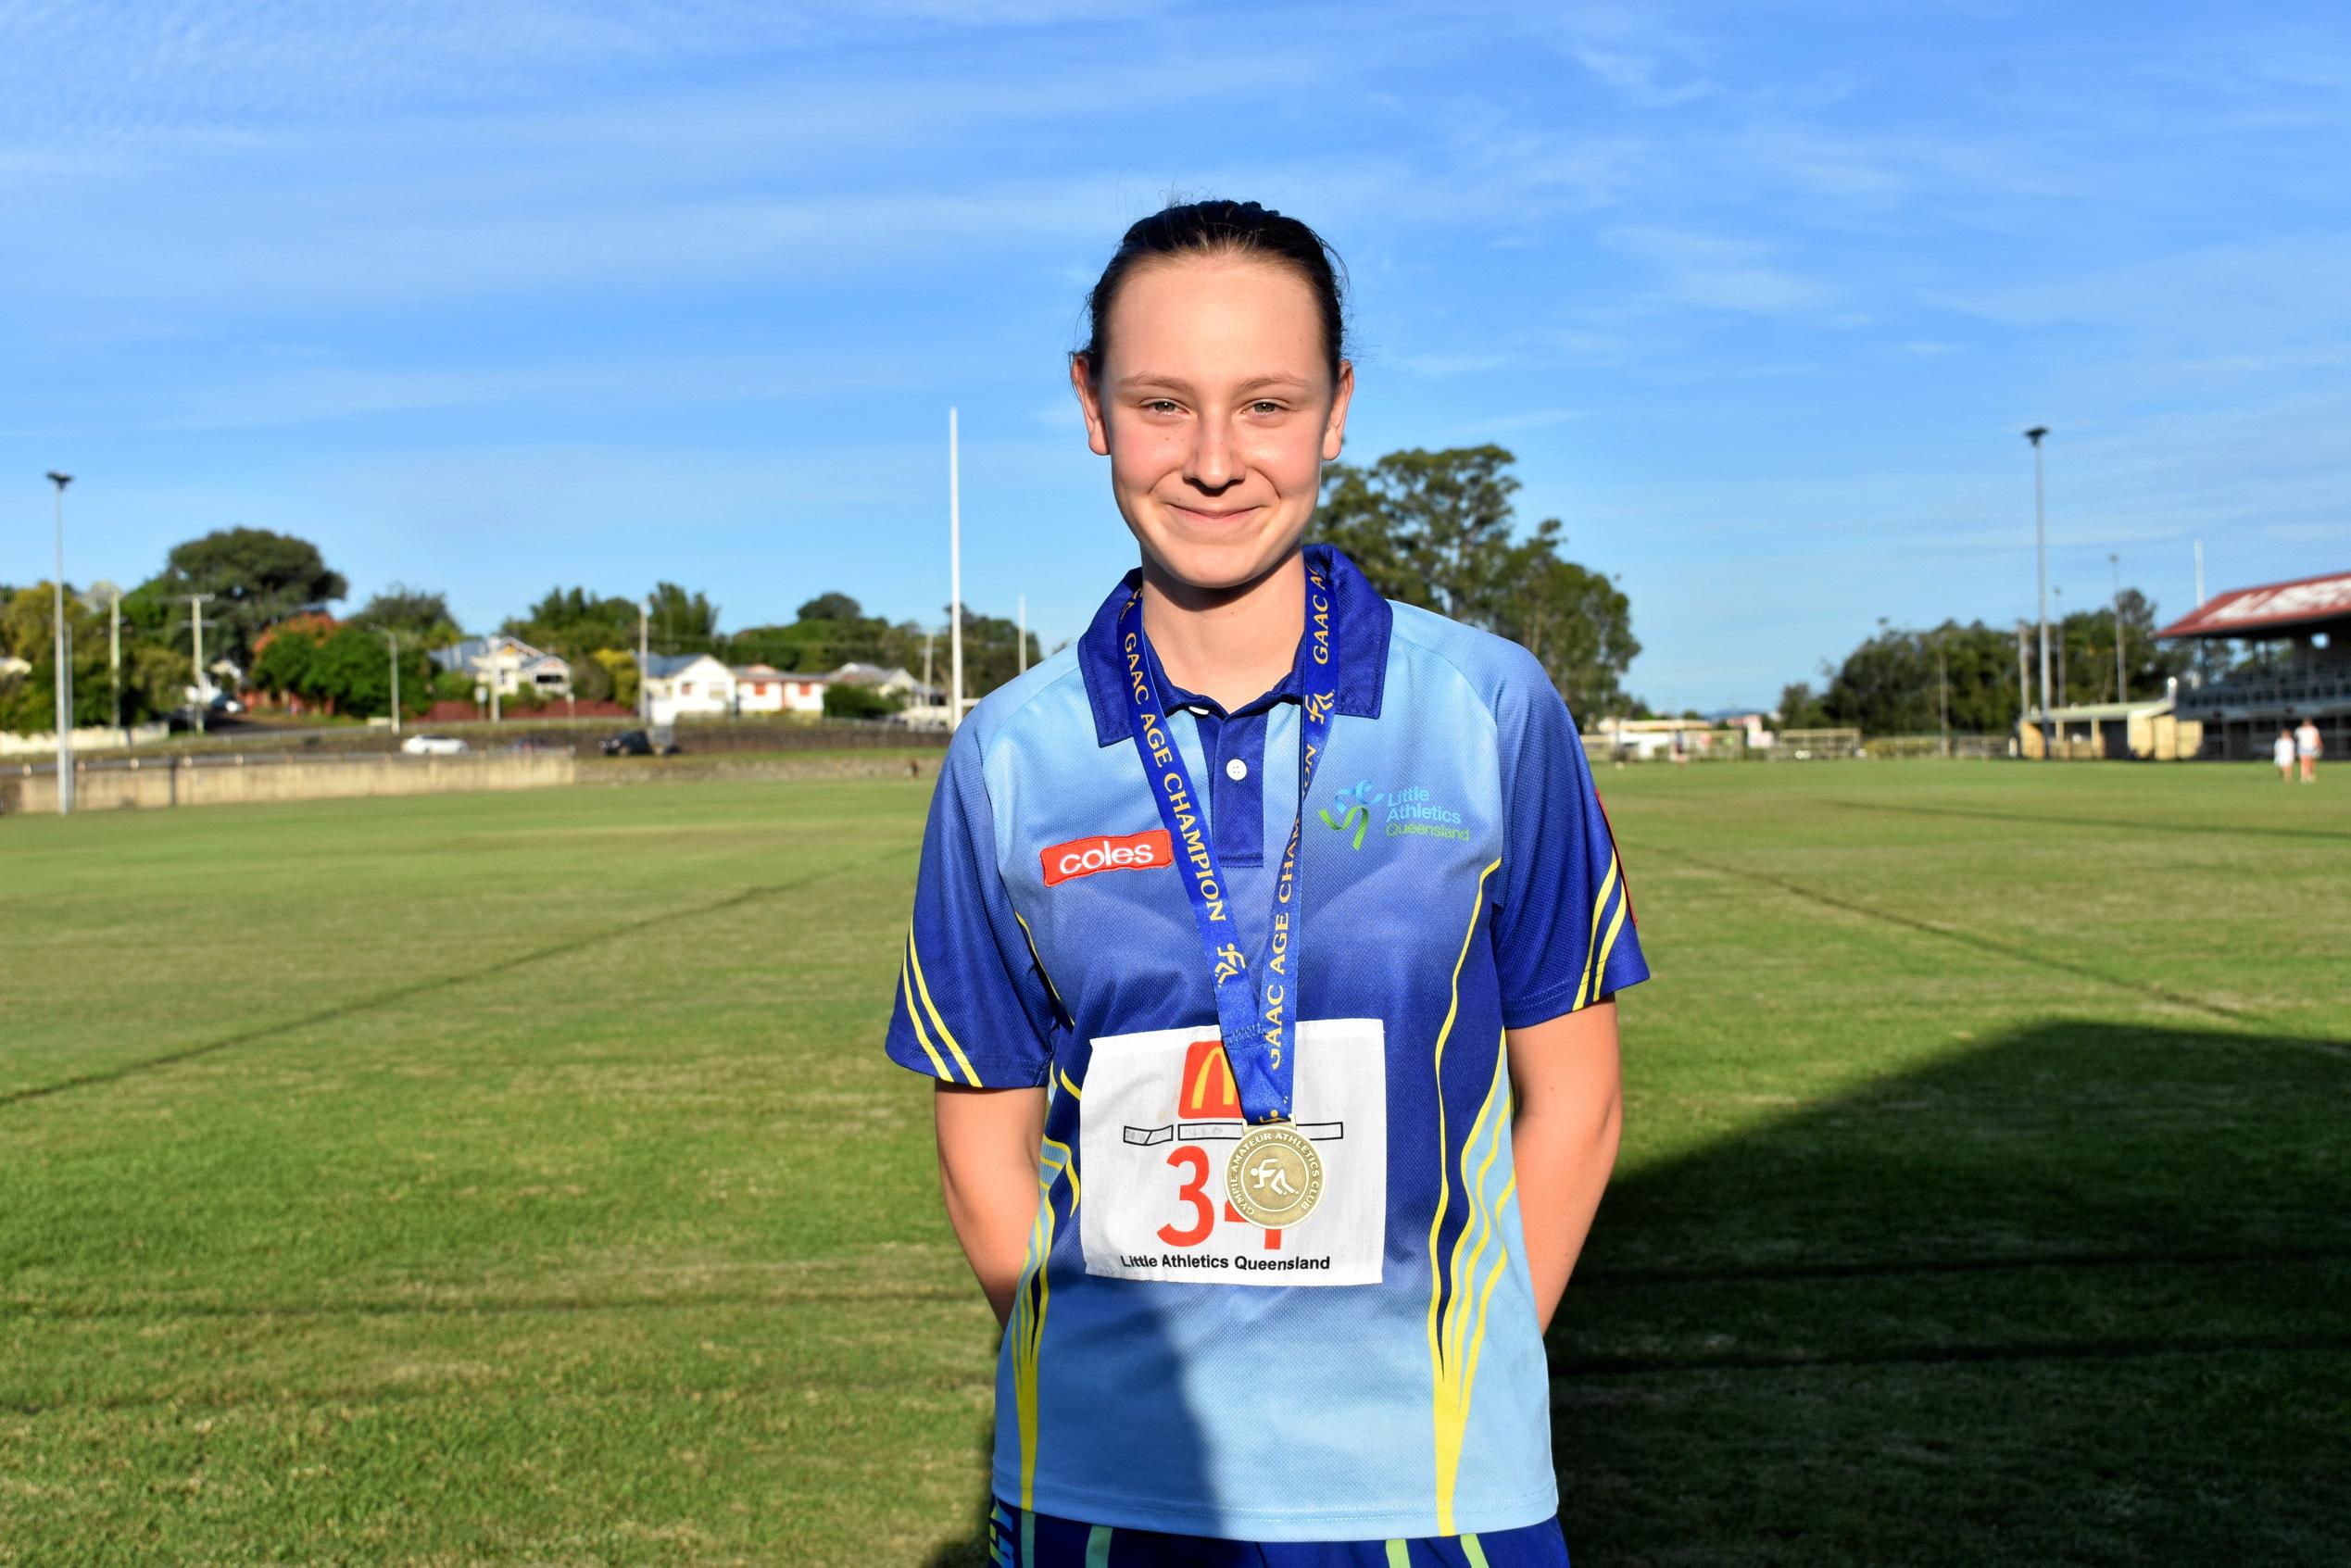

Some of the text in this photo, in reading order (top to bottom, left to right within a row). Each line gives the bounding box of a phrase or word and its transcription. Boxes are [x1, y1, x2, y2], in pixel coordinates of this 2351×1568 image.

[1313, 595, 1328, 665] GAAC
[1125, 633, 1227, 922] GAAC AGE CHAMPION
[1386, 802, 1461, 824] Athletics
[1389, 785, 1429, 807] Little
[1385, 822, 1470, 842] Queensland
[1059, 840, 1154, 874] coles
[1269, 912, 1289, 975] AGE
[1230, 1132, 1320, 1215] GYMPIE AMATEUR ATHLETICS CLUB
[1120, 1254, 1330, 1271] Little Athletics Queensland
